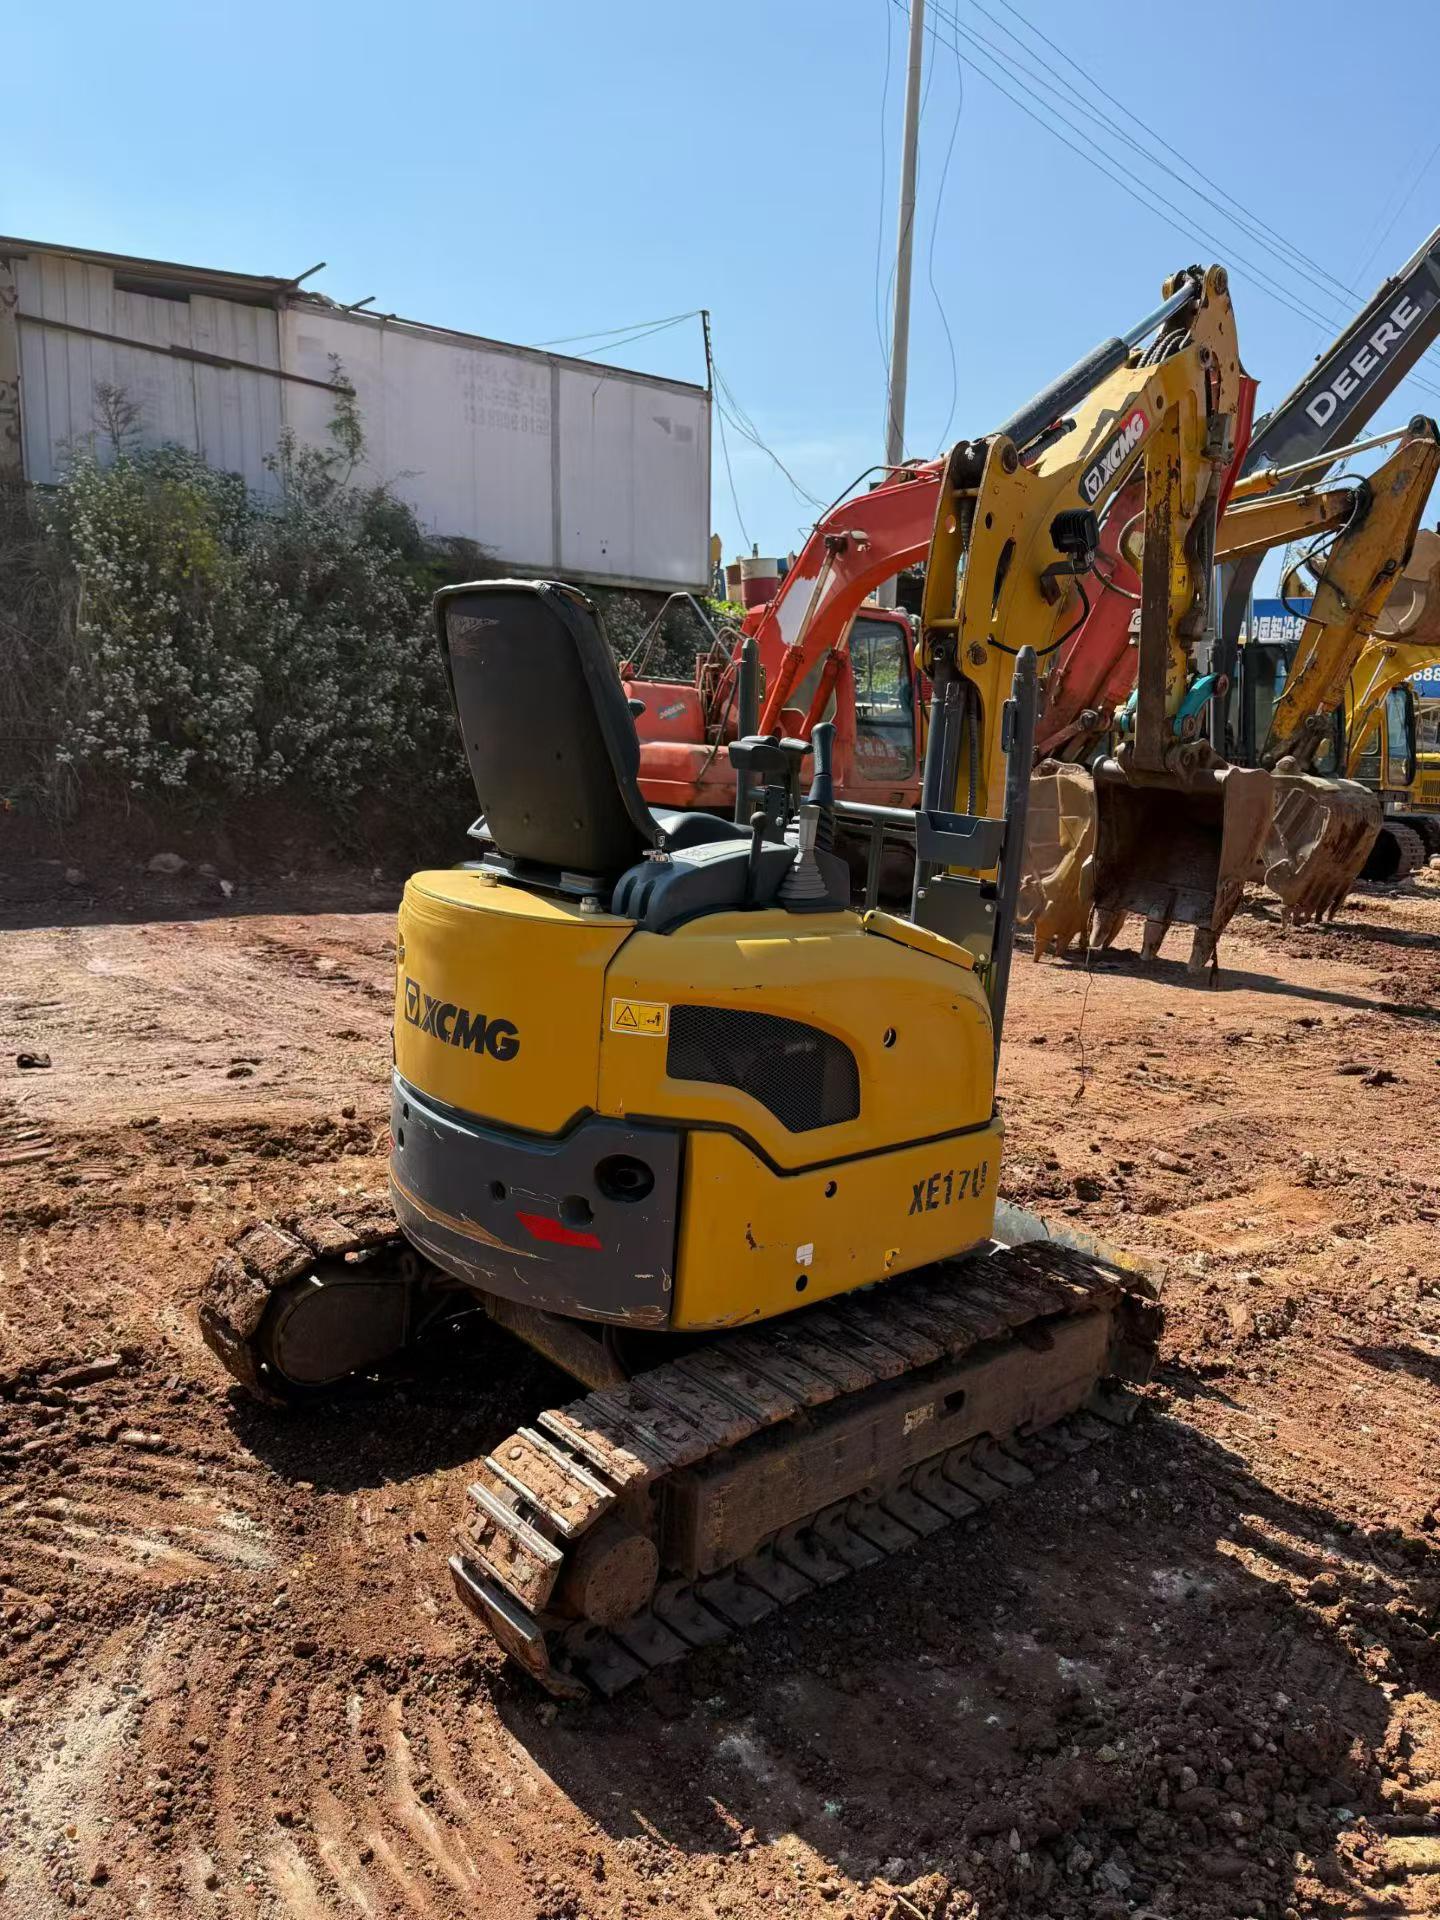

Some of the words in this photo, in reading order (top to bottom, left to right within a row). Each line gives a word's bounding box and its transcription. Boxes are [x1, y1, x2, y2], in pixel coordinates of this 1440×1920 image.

[1305, 295, 1422, 428] DEERE
[1099, 413, 1145, 487] XCMG
[420, 992, 521, 1062] XCMG
[908, 1160, 988, 1216] XE17U
